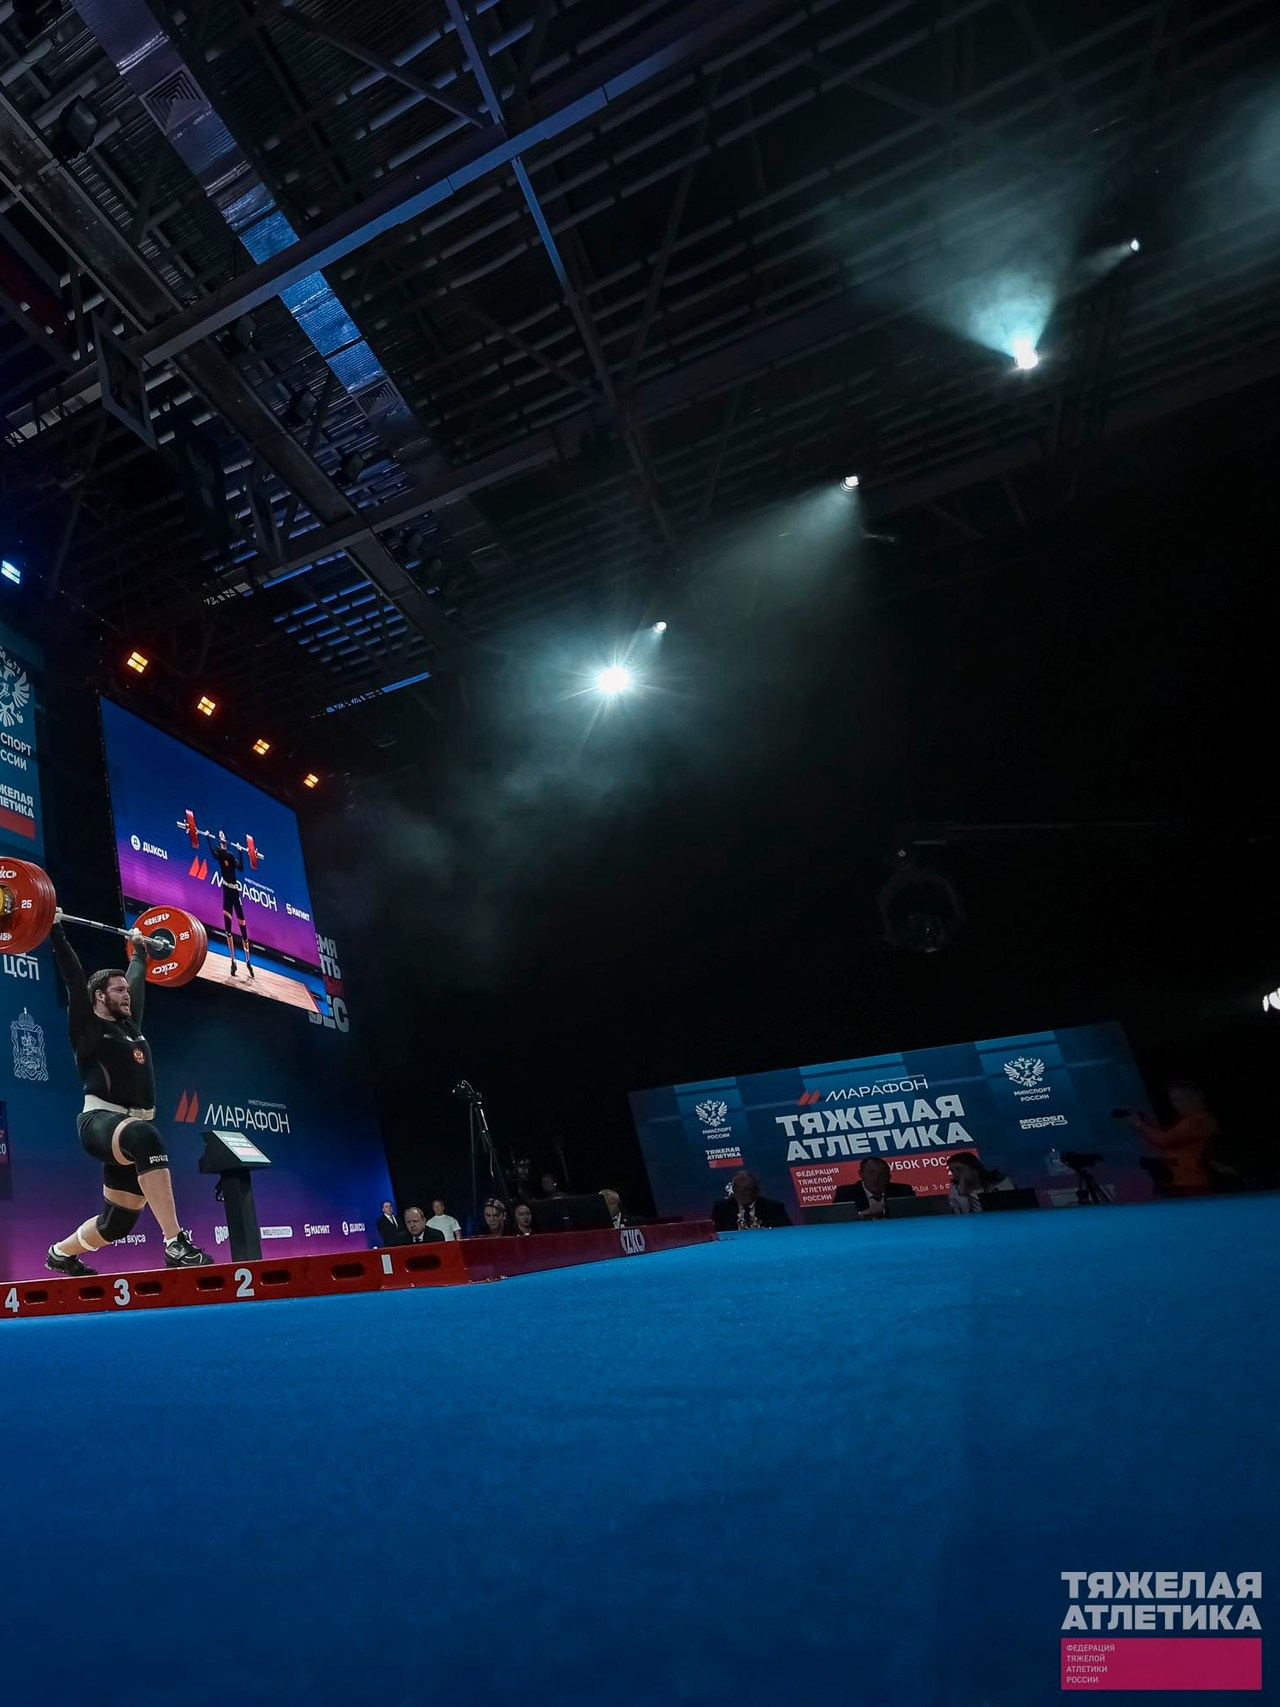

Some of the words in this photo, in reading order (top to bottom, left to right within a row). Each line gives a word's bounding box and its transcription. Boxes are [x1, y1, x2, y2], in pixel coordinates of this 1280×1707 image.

[211, 871, 277, 912] МРАФОН
[21, 899, 33, 909] 25
[3, 953, 40, 981] ЦСП
[826, 1078, 929, 1102] МАРАФОН
[1014, 1087, 1051, 1096] МИНСПОРТ
[1020, 1094, 1049, 1102] РОССИИ
[204, 1103, 291, 1134] МАРАФОН
[775, 1094, 965, 1137] ТЯЖЕЛАЯ
[787, 1122, 974, 1161] АТЛЕТИКА
[795, 1168, 839, 1177] ФЕДЕРАЦИЯ
[887, 1160, 920, 1171] УБОК
[798, 1176, 833, 1185] ТЯЖЕЛОЙ
[801, 1185, 837, 1194] АТЛЕТИКИ
[803, 1194, 832, 1202] РОССИИ
[114, 1278, 131, 1306] 3
[234, 1268, 255, 1298] 2
[4, 1288, 20, 1313] 4
